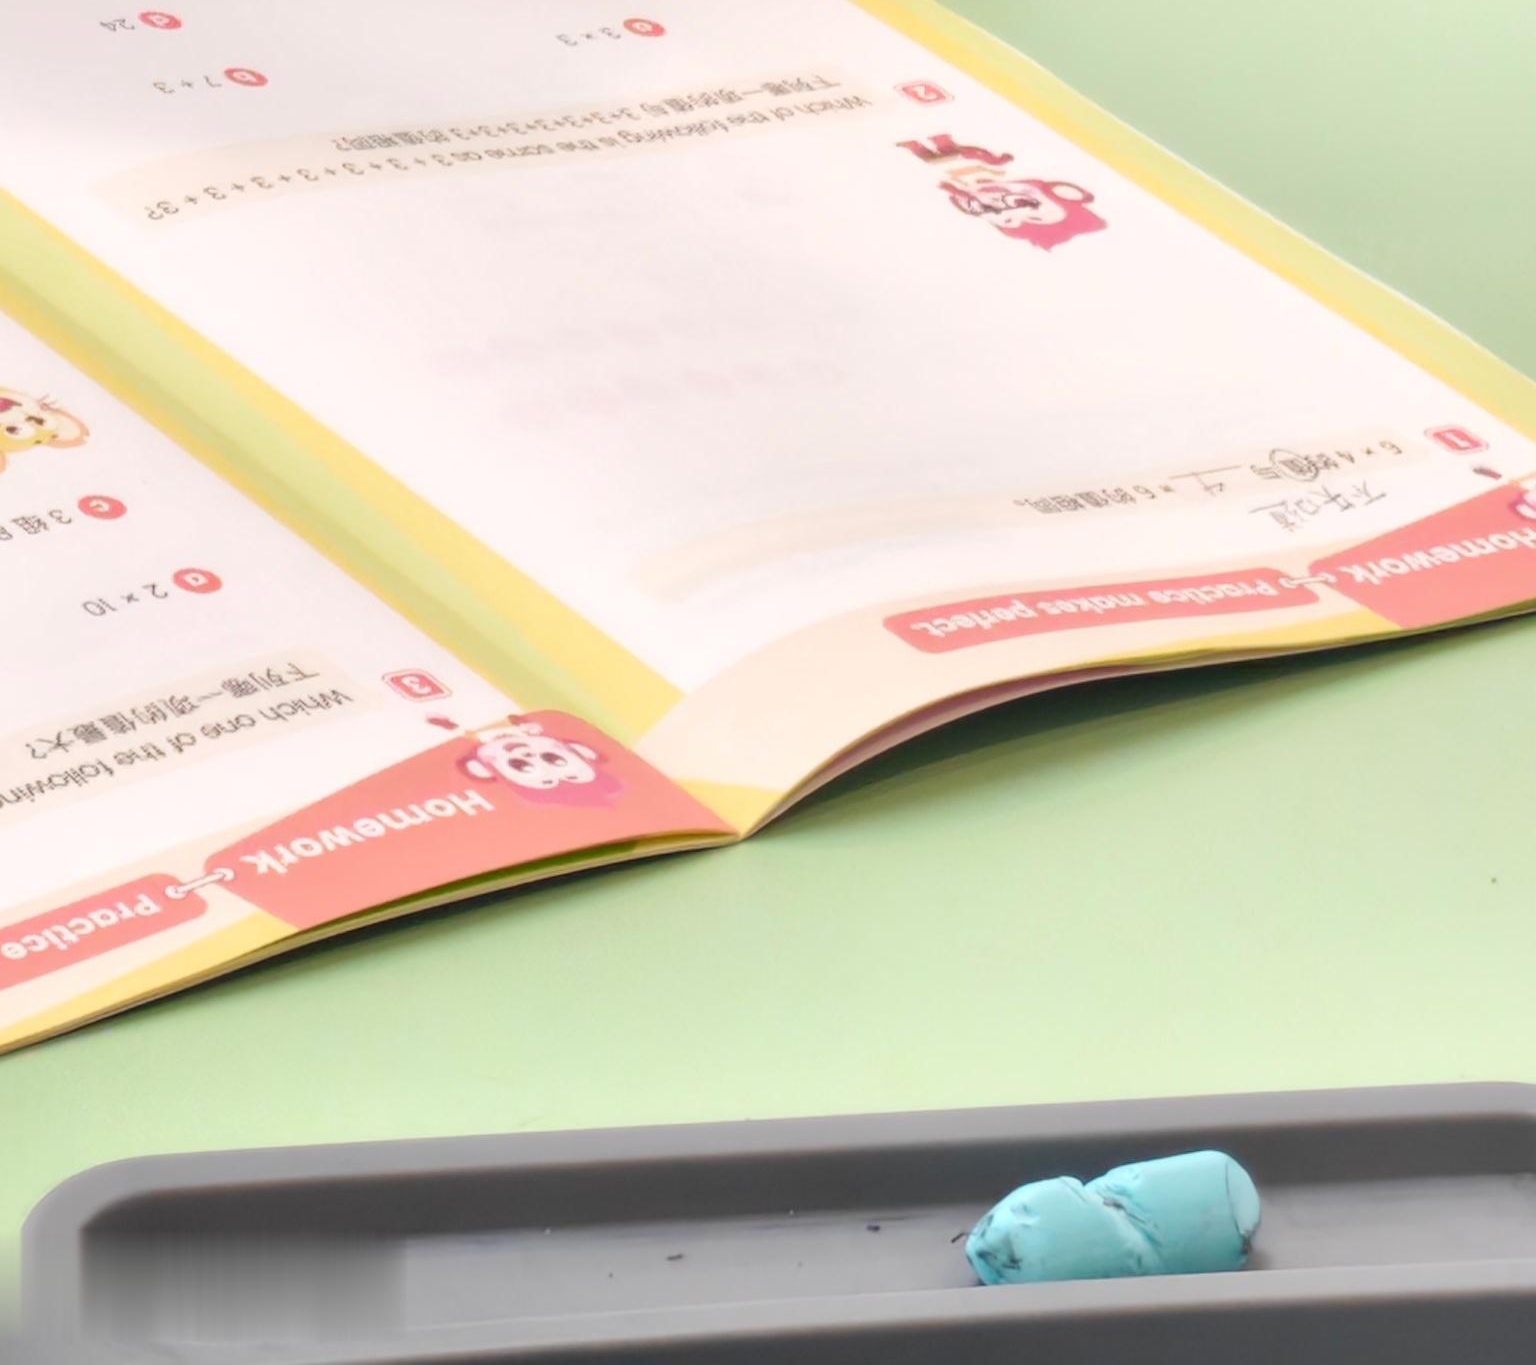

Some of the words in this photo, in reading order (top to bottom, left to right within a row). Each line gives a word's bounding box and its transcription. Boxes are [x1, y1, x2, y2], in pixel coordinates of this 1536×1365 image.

[794, 94, 872, 115] Which
[726, 109, 769, 127] the
[618, 118, 728, 145] following
[484, 143, 554, 162] same
[555, 139, 595, 155] the
[48, 509, 72, 525] 3
[1337, 527, 1536, 585] Homework
[143, 583, 168, 600] 2
[1037, 591, 1146, 616] makes
[1147, 578, 1279, 607] Practice
[81, 598, 117, 617] 10
[910, 599, 1036, 638] perfect.
[258, 688, 353, 723] Which
[200, 713, 256, 740] one
[113, 742, 166, 767] the
[165, 732, 197, 754] of
[239, 789, 495, 875] Homework
[0, 893, 162, 964] Practice
